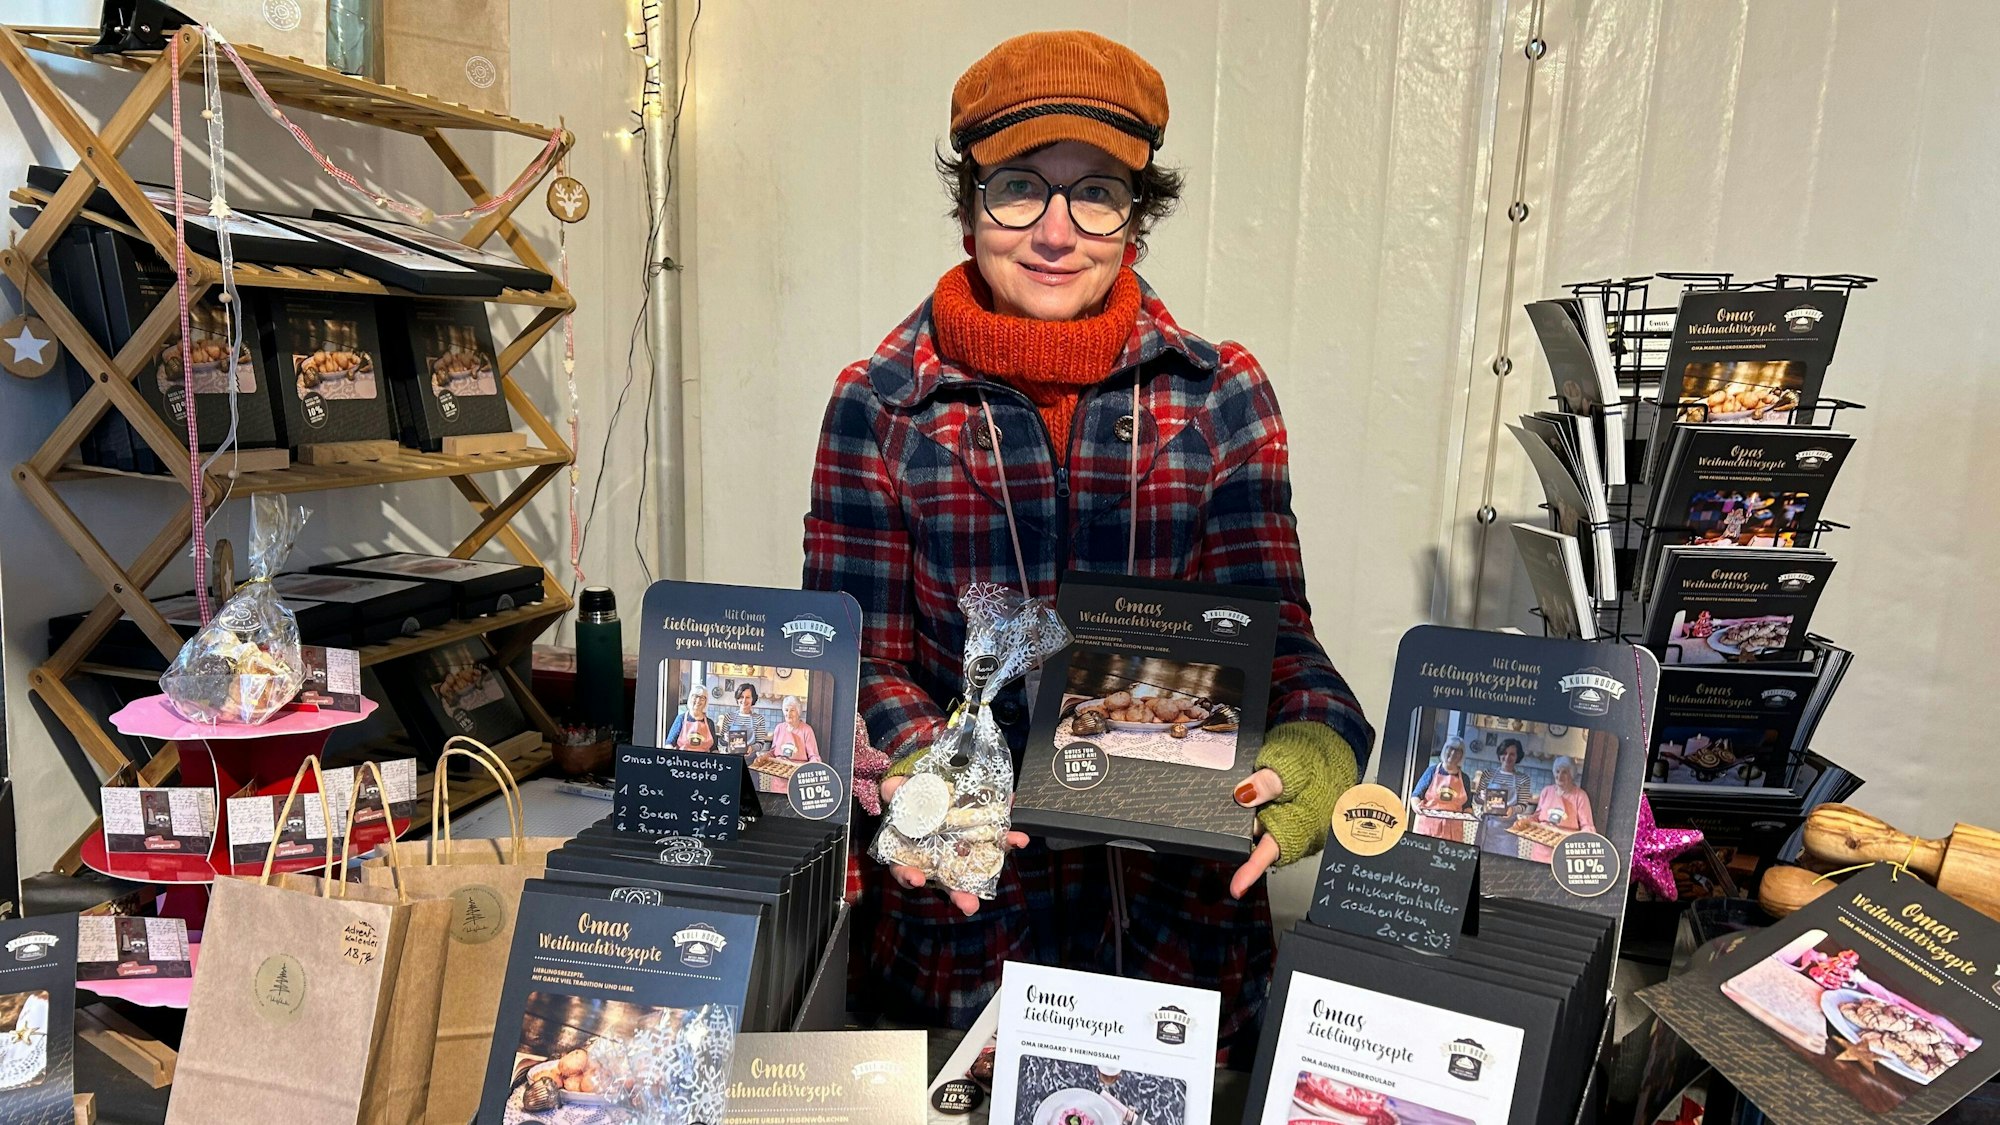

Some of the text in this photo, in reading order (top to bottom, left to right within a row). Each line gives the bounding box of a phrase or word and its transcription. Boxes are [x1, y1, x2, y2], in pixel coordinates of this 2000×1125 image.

[1716, 308, 1756, 323] Omas
[1689, 321, 1777, 337] Weihnachtsrezepte
[307, 405, 324, 417] 10%
[442, 401, 456, 412] 10%
[1730, 445, 1765, 461] Opas
[1698, 457, 1786, 471] Weihnachtsrezepte
[1711, 569, 1750, 582] Omas
[1682, 580, 1770, 593] Weihnachtsrezepte
[1114, 597, 1165, 617] Omas
[724, 609, 766, 623] Mit Omas
[1079, 610, 1193, 634] Weihnachtsrezepte
[663, 616, 766, 640] Lieblingsrezepten
[790, 622, 806, 631] KULI
[676, 637, 764, 652] gegen Altersarmut:
[1492, 657, 1542, 675] Mit Omas
[1420, 662, 1539, 692] Lieblingsrezepten
[1569, 676, 1616, 690] KULI HOOD
[1433, 684, 1536, 706] gegen Altersarmut:
[1696, 682, 1732, 697] Omas
[1668, 694, 1753, 709] Weihnachtsrezepte
[621, 755, 732, 771] Omas Weihnachts-
[1064, 760, 1097, 773] 10%
[670, 768, 718, 781] Rezepte
[619, 784, 629, 795] 1
[638, 784, 664, 796] Box
[799, 785, 831, 800] 10%
[618, 806, 627, 817] 2
[639, 806, 678, 820] Boxen
[1371, 810, 1391, 823] HOOD
[617, 823, 626, 831] 4
[1326, 862, 1346, 874] 15
[1430, 855, 1456, 871] Box
[1566, 858, 1605, 873] 10%
[1324, 879, 1335, 889] 1
[1319, 895, 1330, 906] 1
[578, 912, 633, 942] Omas
[1902, 903, 1960, 944] Omas
[702, 933, 719, 943] HOOD
[1852, 893, 1978, 976] Weihnachtsrezepte
[539, 933, 662, 965] Weihnachtsrezepte
[1838, 916, 1855, 929] OMA
[1885, 945, 1945, 986] NUSSMAKRONEN
[532, 967, 585, 979] LIEBLINGSREZEPTE.
[542, 975, 560, 983] GANZ
[572, 979, 603, 988] TRADITION
[618, 984, 635, 992] LIEBE.
[1026, 985, 1078, 1012] Omas
[1023, 1007, 1126, 1037] Lieblingsrezepte
[1312, 998, 1367, 1031] Omas
[1307, 1021, 1414, 1063] Lieblingsrezepte
[1074, 1048, 1120, 1060] HERINGSSALAT
[751, 1058, 808, 1080] Omas
[1301, 1055, 1396, 1088] OMA AGNES RINDERROULADE
[725, 1081, 843, 1103] eihnachtsrezepte
[942, 1093, 972, 1103] 10%
